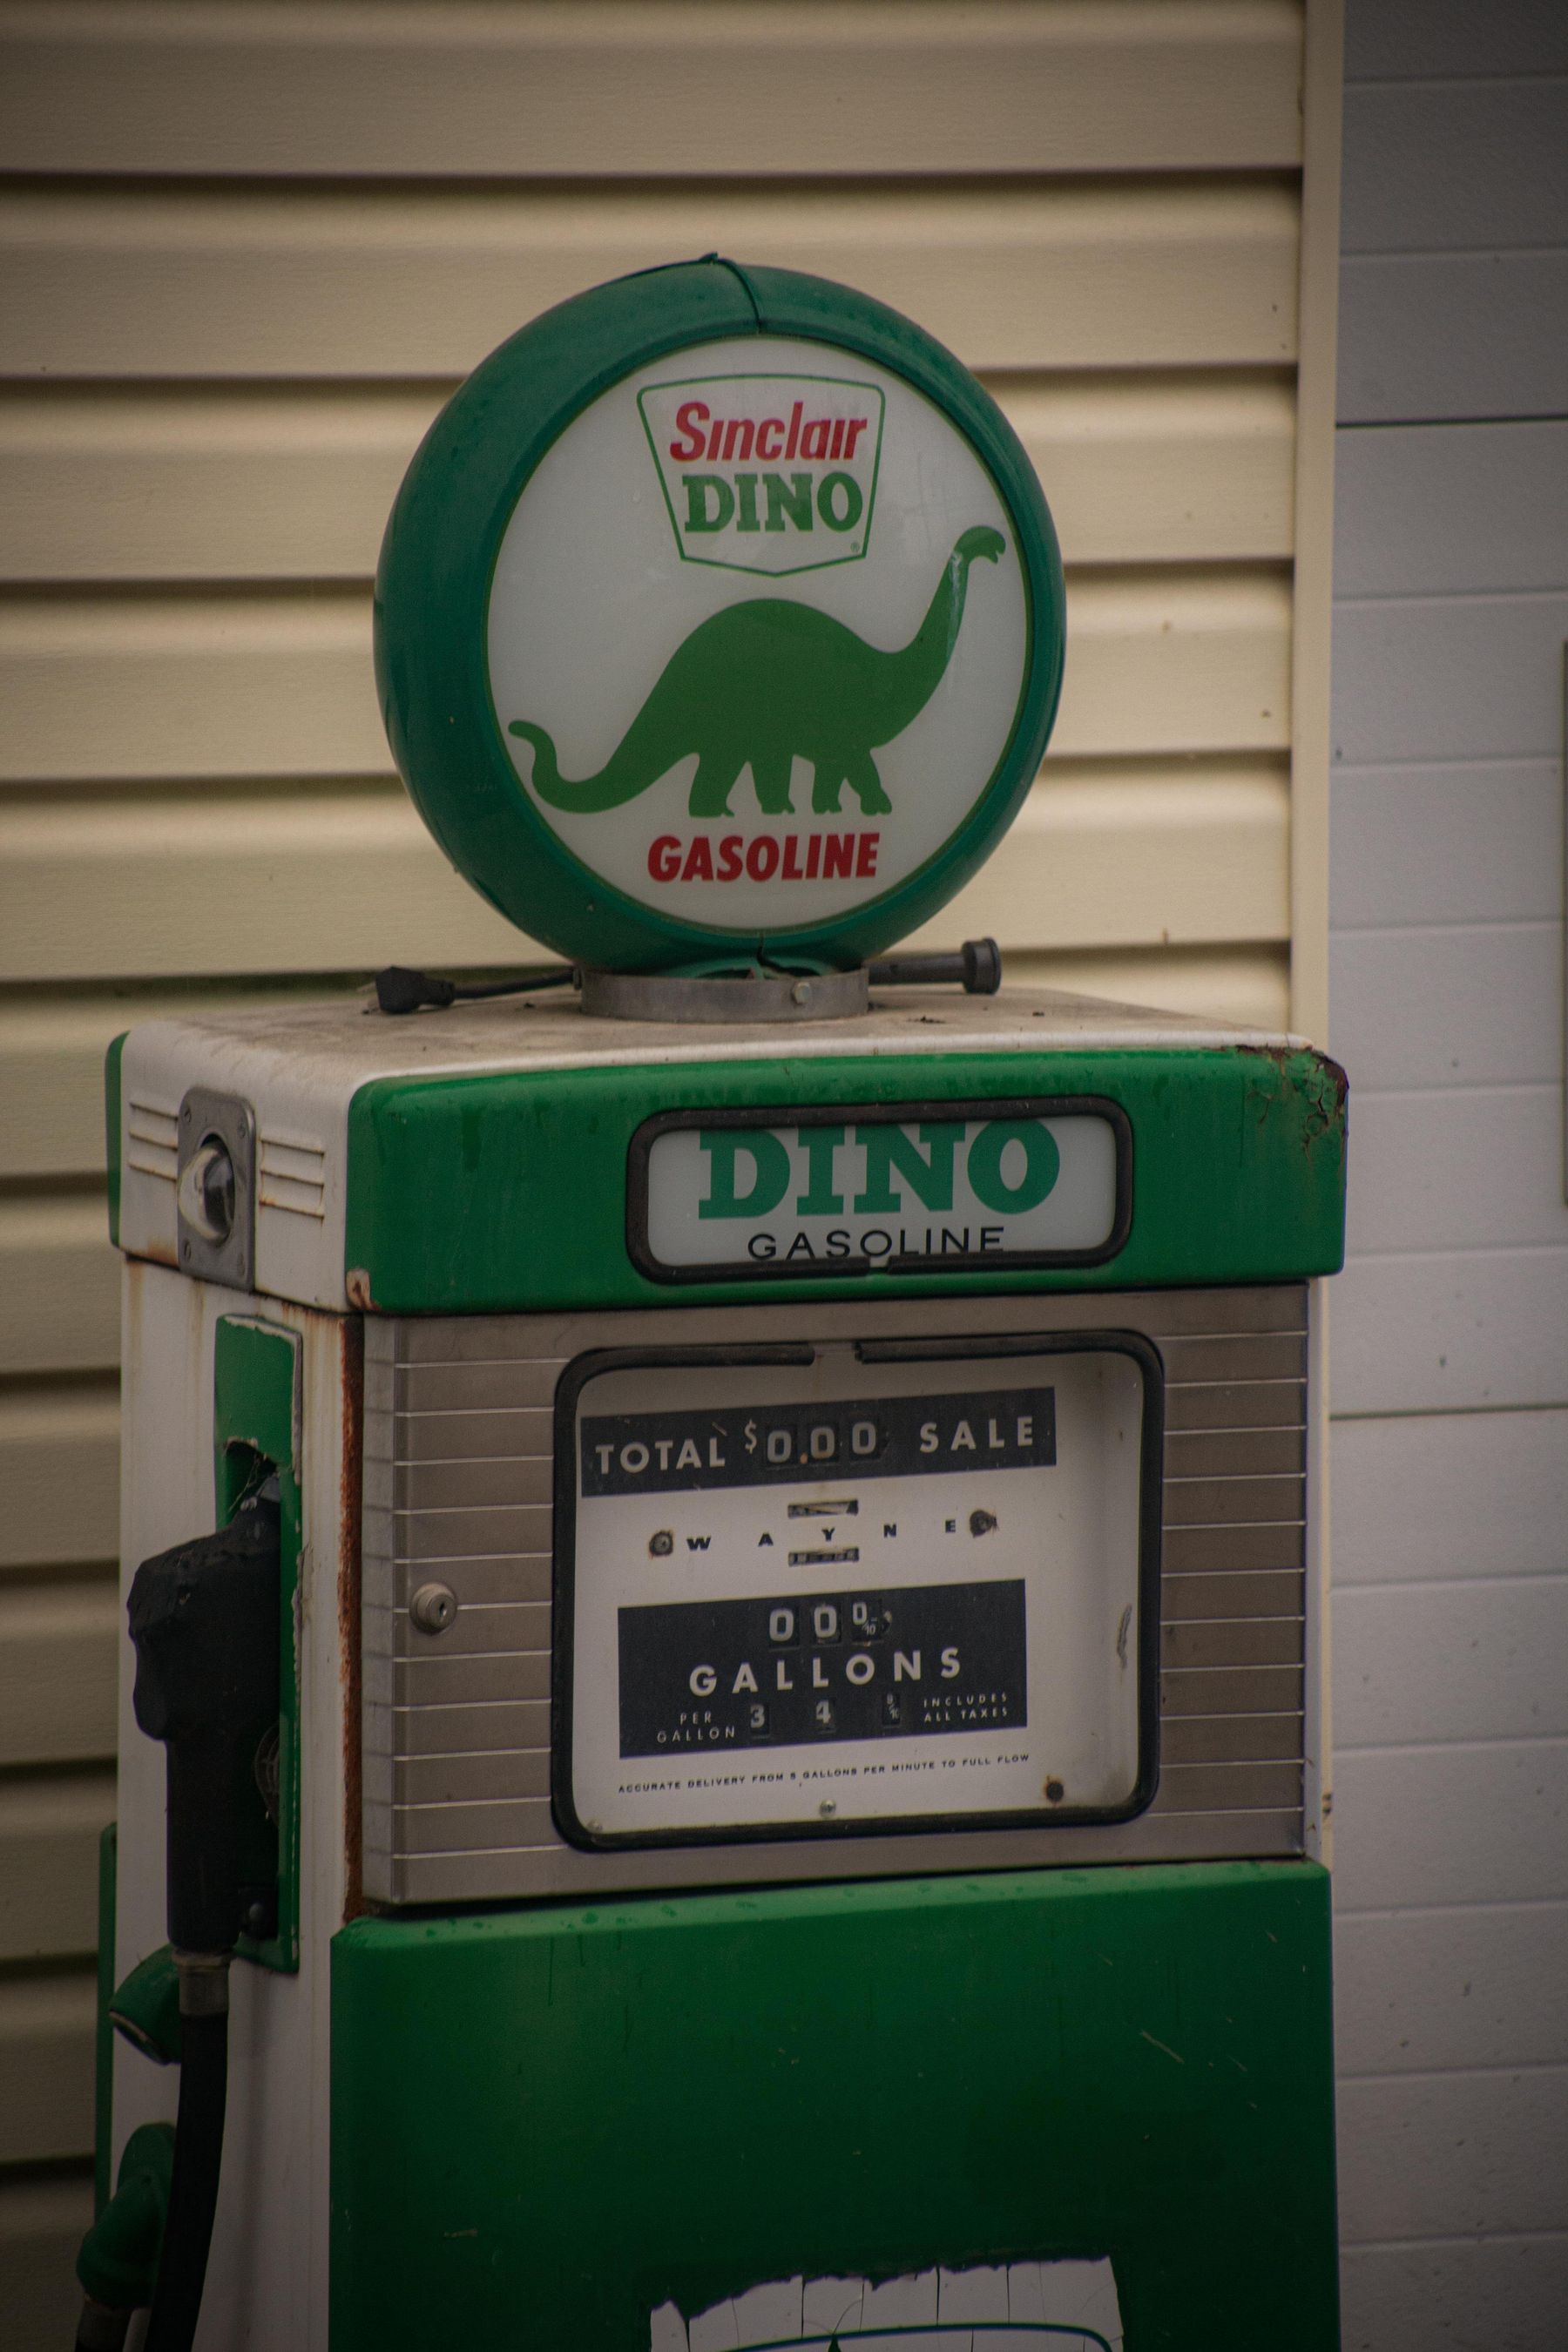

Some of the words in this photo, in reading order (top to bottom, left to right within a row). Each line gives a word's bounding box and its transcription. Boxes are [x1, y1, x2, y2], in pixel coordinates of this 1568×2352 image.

[682, 471, 863, 533] DINO
[647, 832, 880, 882] GASOLINE
[699, 1119, 1060, 1220] DINO
[747, 1227, 1004, 1261] GASOLINE
[595, 1438, 726, 1475] TOTAL
[919, 1416, 1033, 1453] SALE
[689, 1647, 961, 1697] GALLONS
[679, 1711, 712, 1725] PER
[750, 1704, 765, 1728] 3
[815, 1700, 831, 1724] 4
[923, 1693, 1008, 1708] INCLUDES
[923, 1712, 950, 1722] ALL
[961, 1707, 1008, 1720] TAXES
[657, 1727, 735, 1743] GALLON
[618, 1781, 681, 1794] ACCURATE
[687, 1776, 746, 1788] DELIVERY
[752, 1773, 784, 1782] FROM
[802, 1767, 858, 1780] GALLONS
[863, 1766, 885, 1775] PER
[892, 1761, 936, 1772] MINUTE
[942, 1760, 956, 1768] TO
[963, 1756, 991, 1767] FULL
[997, 1754, 1031, 1764] FLOW
